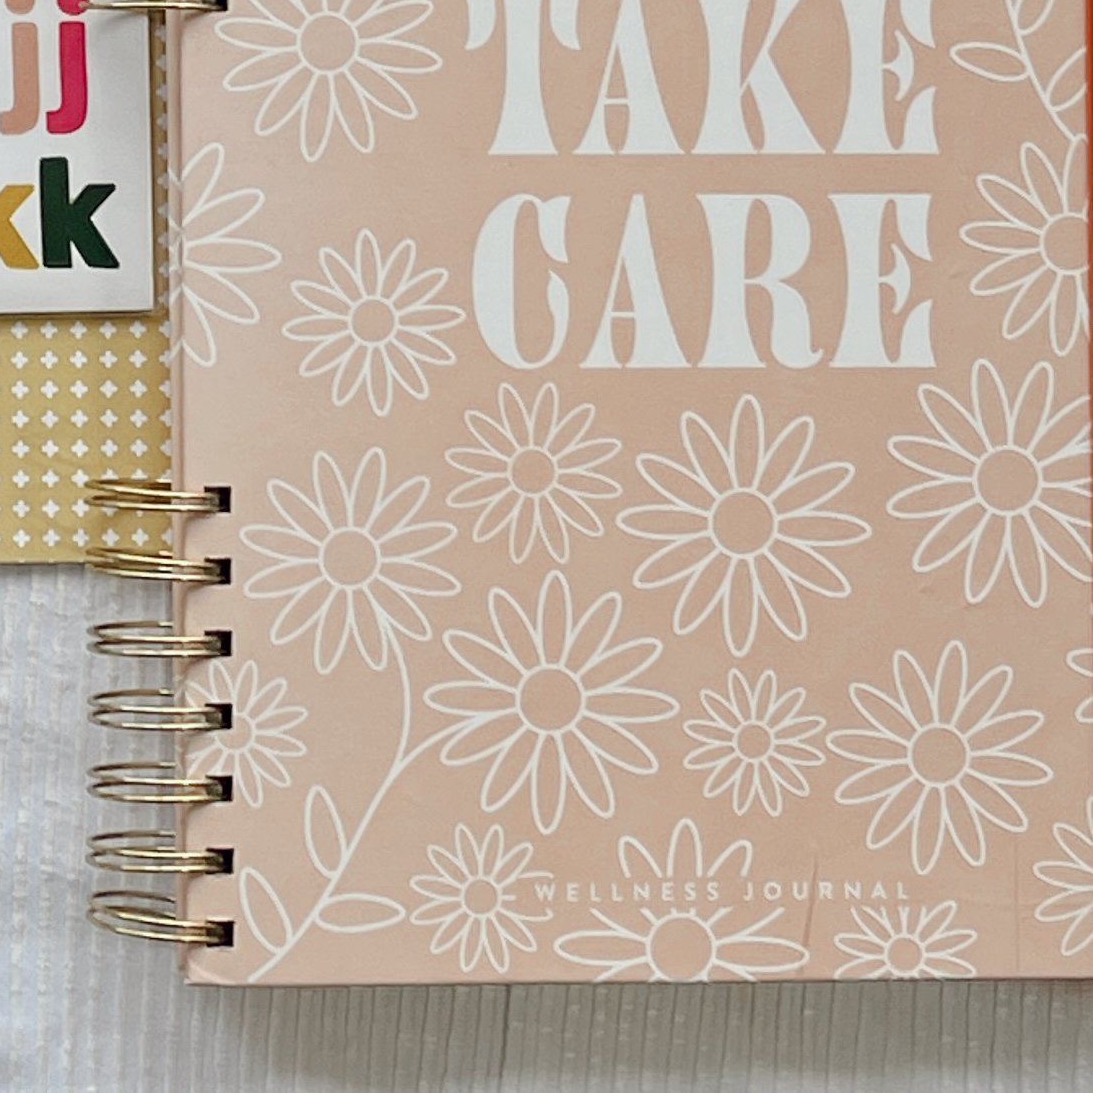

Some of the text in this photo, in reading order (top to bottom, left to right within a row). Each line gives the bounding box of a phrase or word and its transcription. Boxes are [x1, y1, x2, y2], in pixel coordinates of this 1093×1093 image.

[473, 193, 937, 370] CARE
[534, 881, 911, 901] WELLNESS JOURNAL
